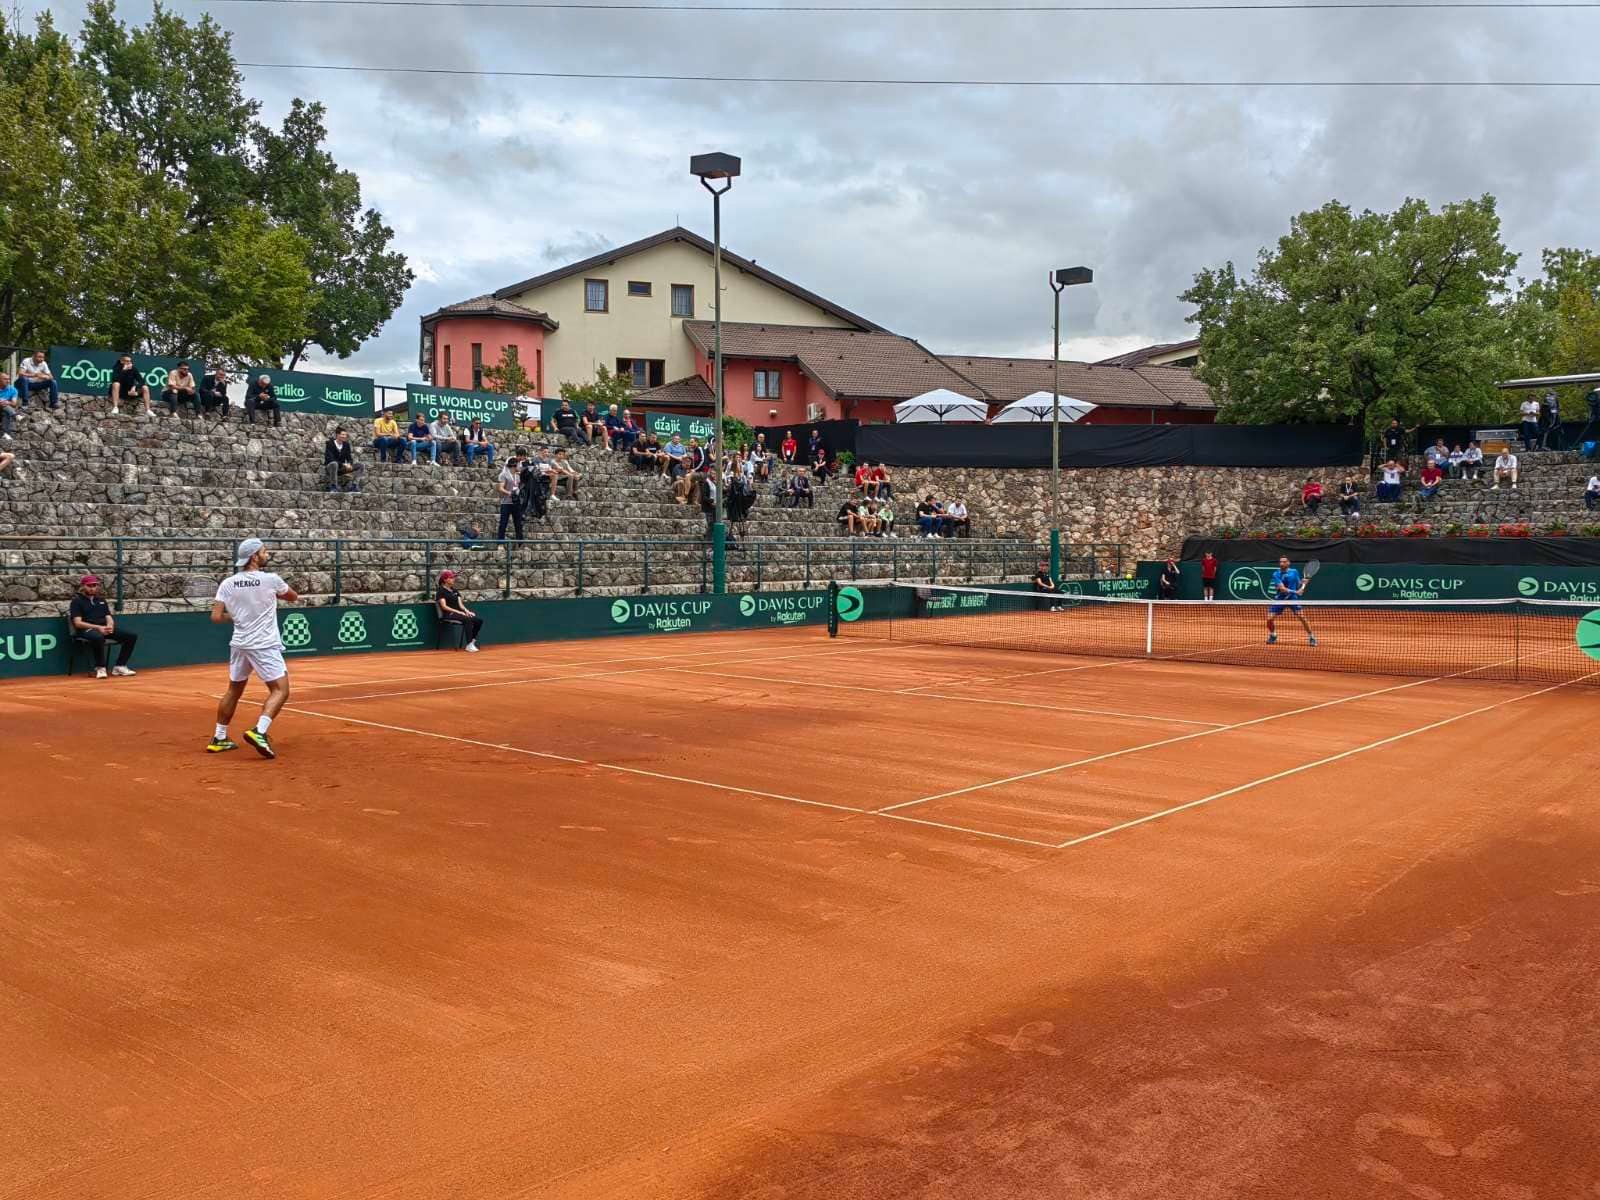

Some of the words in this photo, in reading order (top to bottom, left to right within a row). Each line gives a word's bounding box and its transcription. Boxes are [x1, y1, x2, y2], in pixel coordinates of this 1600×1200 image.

[273, 384, 305, 397] arliko
[325, 387, 362, 402] karliko
[412, 392, 437, 405] THE
[439, 395, 482, 409] WORLD
[484, 400, 508, 412] CUP
[233, 579, 261, 588] MEXICO
[1098, 581, 1111, 591] THE
[1112, 580, 1135, 591] WORLD
[1136, 579, 1149, 589] CUP
[1232, 580, 1251, 590] ITF
[1378, 577, 1424, 589] DAVIS
[1428, 579, 1463, 590] CUP
[1544, 581, 1597, 594] DAVIS
[1400, 589, 1438, 599] Rakuten
[633, 602, 678, 617] DAVIS
[681, 601, 712, 614] CUP
[758, 598, 795, 611] DAVIS
[798, 596, 823, 609] CUP
[776, 611, 806, 623] Rakuten
[656, 617, 691, 631] Rakuten
